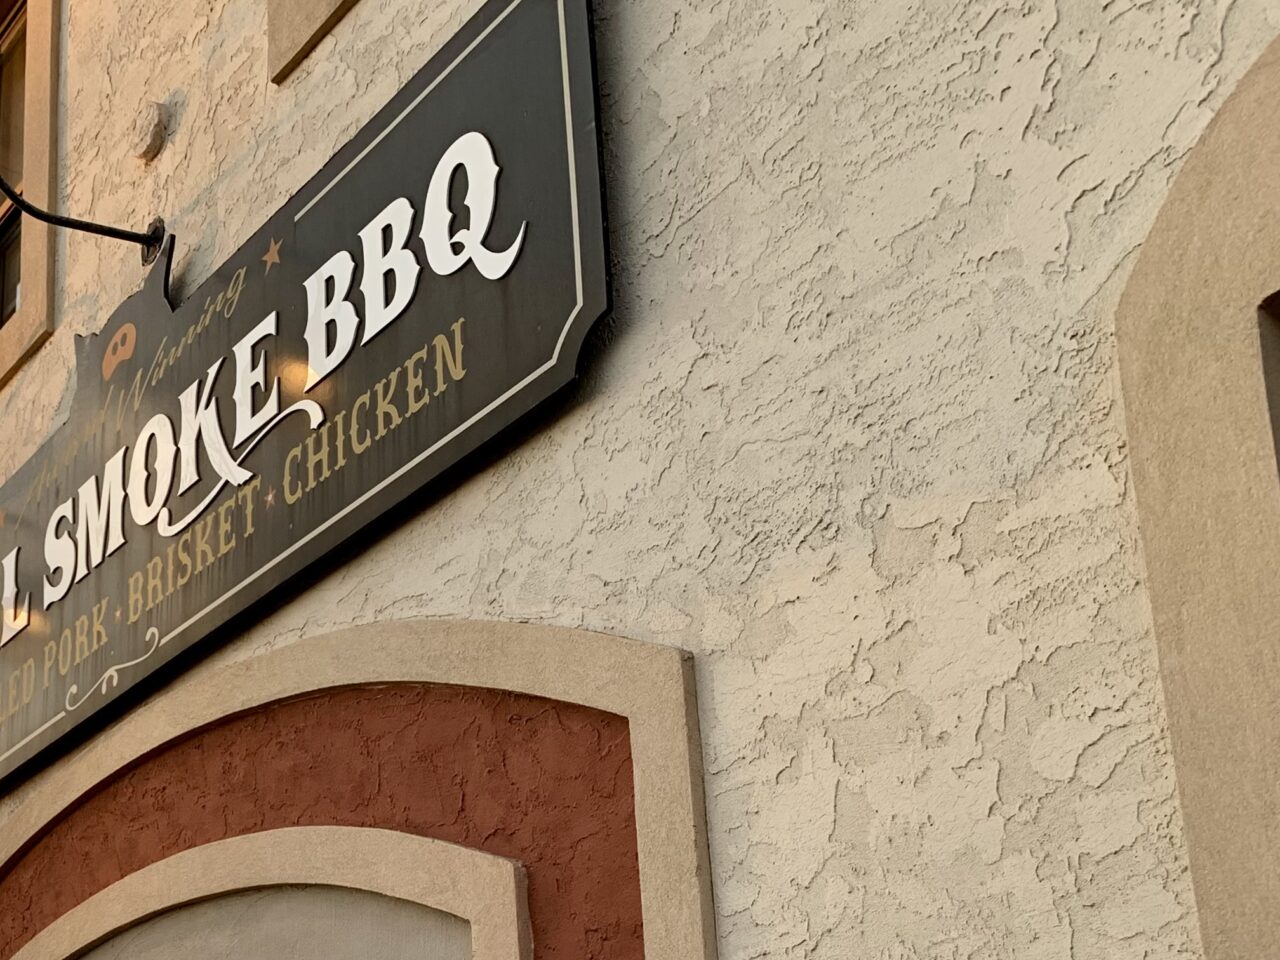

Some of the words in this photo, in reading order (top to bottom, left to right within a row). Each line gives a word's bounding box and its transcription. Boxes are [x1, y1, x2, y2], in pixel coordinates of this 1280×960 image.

[42, 310, 282, 612] SMOKE
[301, 131, 528, 393] BBQ
[42, 597, 110, 690] PORK
[126, 474, 262, 626] BRISKET
[281, 316, 468, 505] CHICKEN
